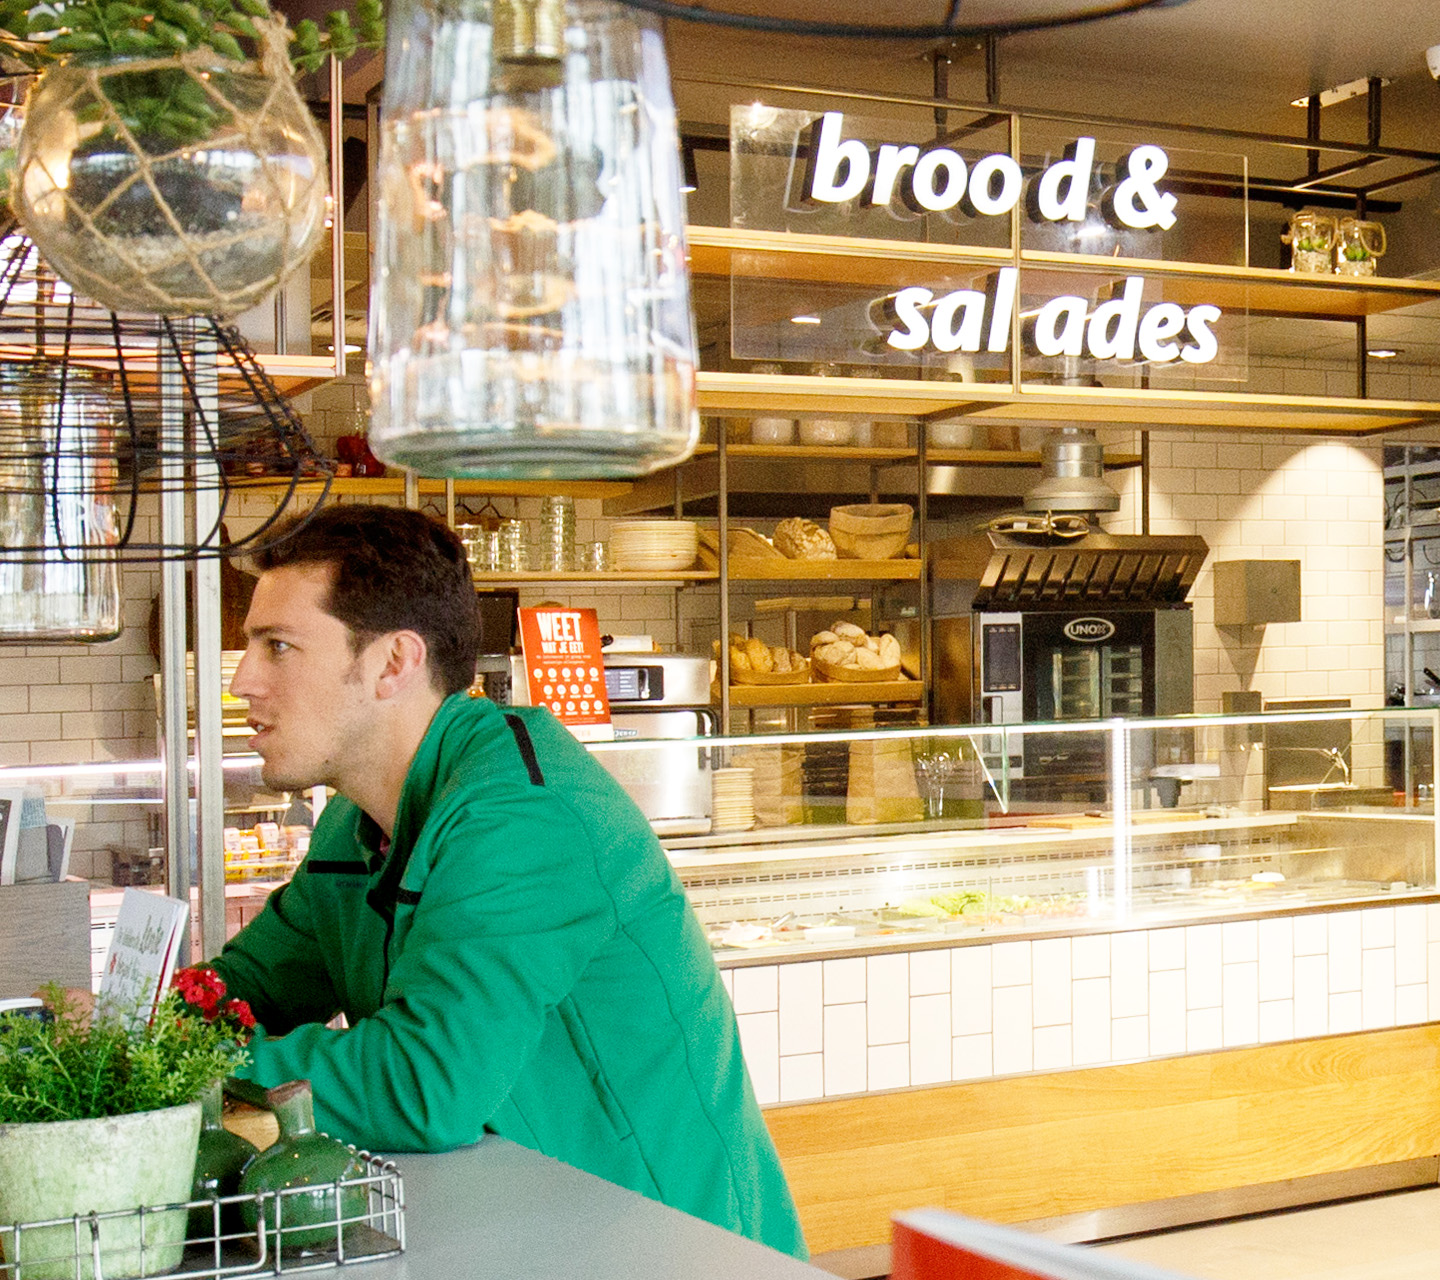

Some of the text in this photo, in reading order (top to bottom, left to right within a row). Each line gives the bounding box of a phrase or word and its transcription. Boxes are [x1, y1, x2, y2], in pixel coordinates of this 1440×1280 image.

[1114, 145, 1178, 230] &
[536, 612, 581, 641] WEET
[559, 642, 568, 653] JE
